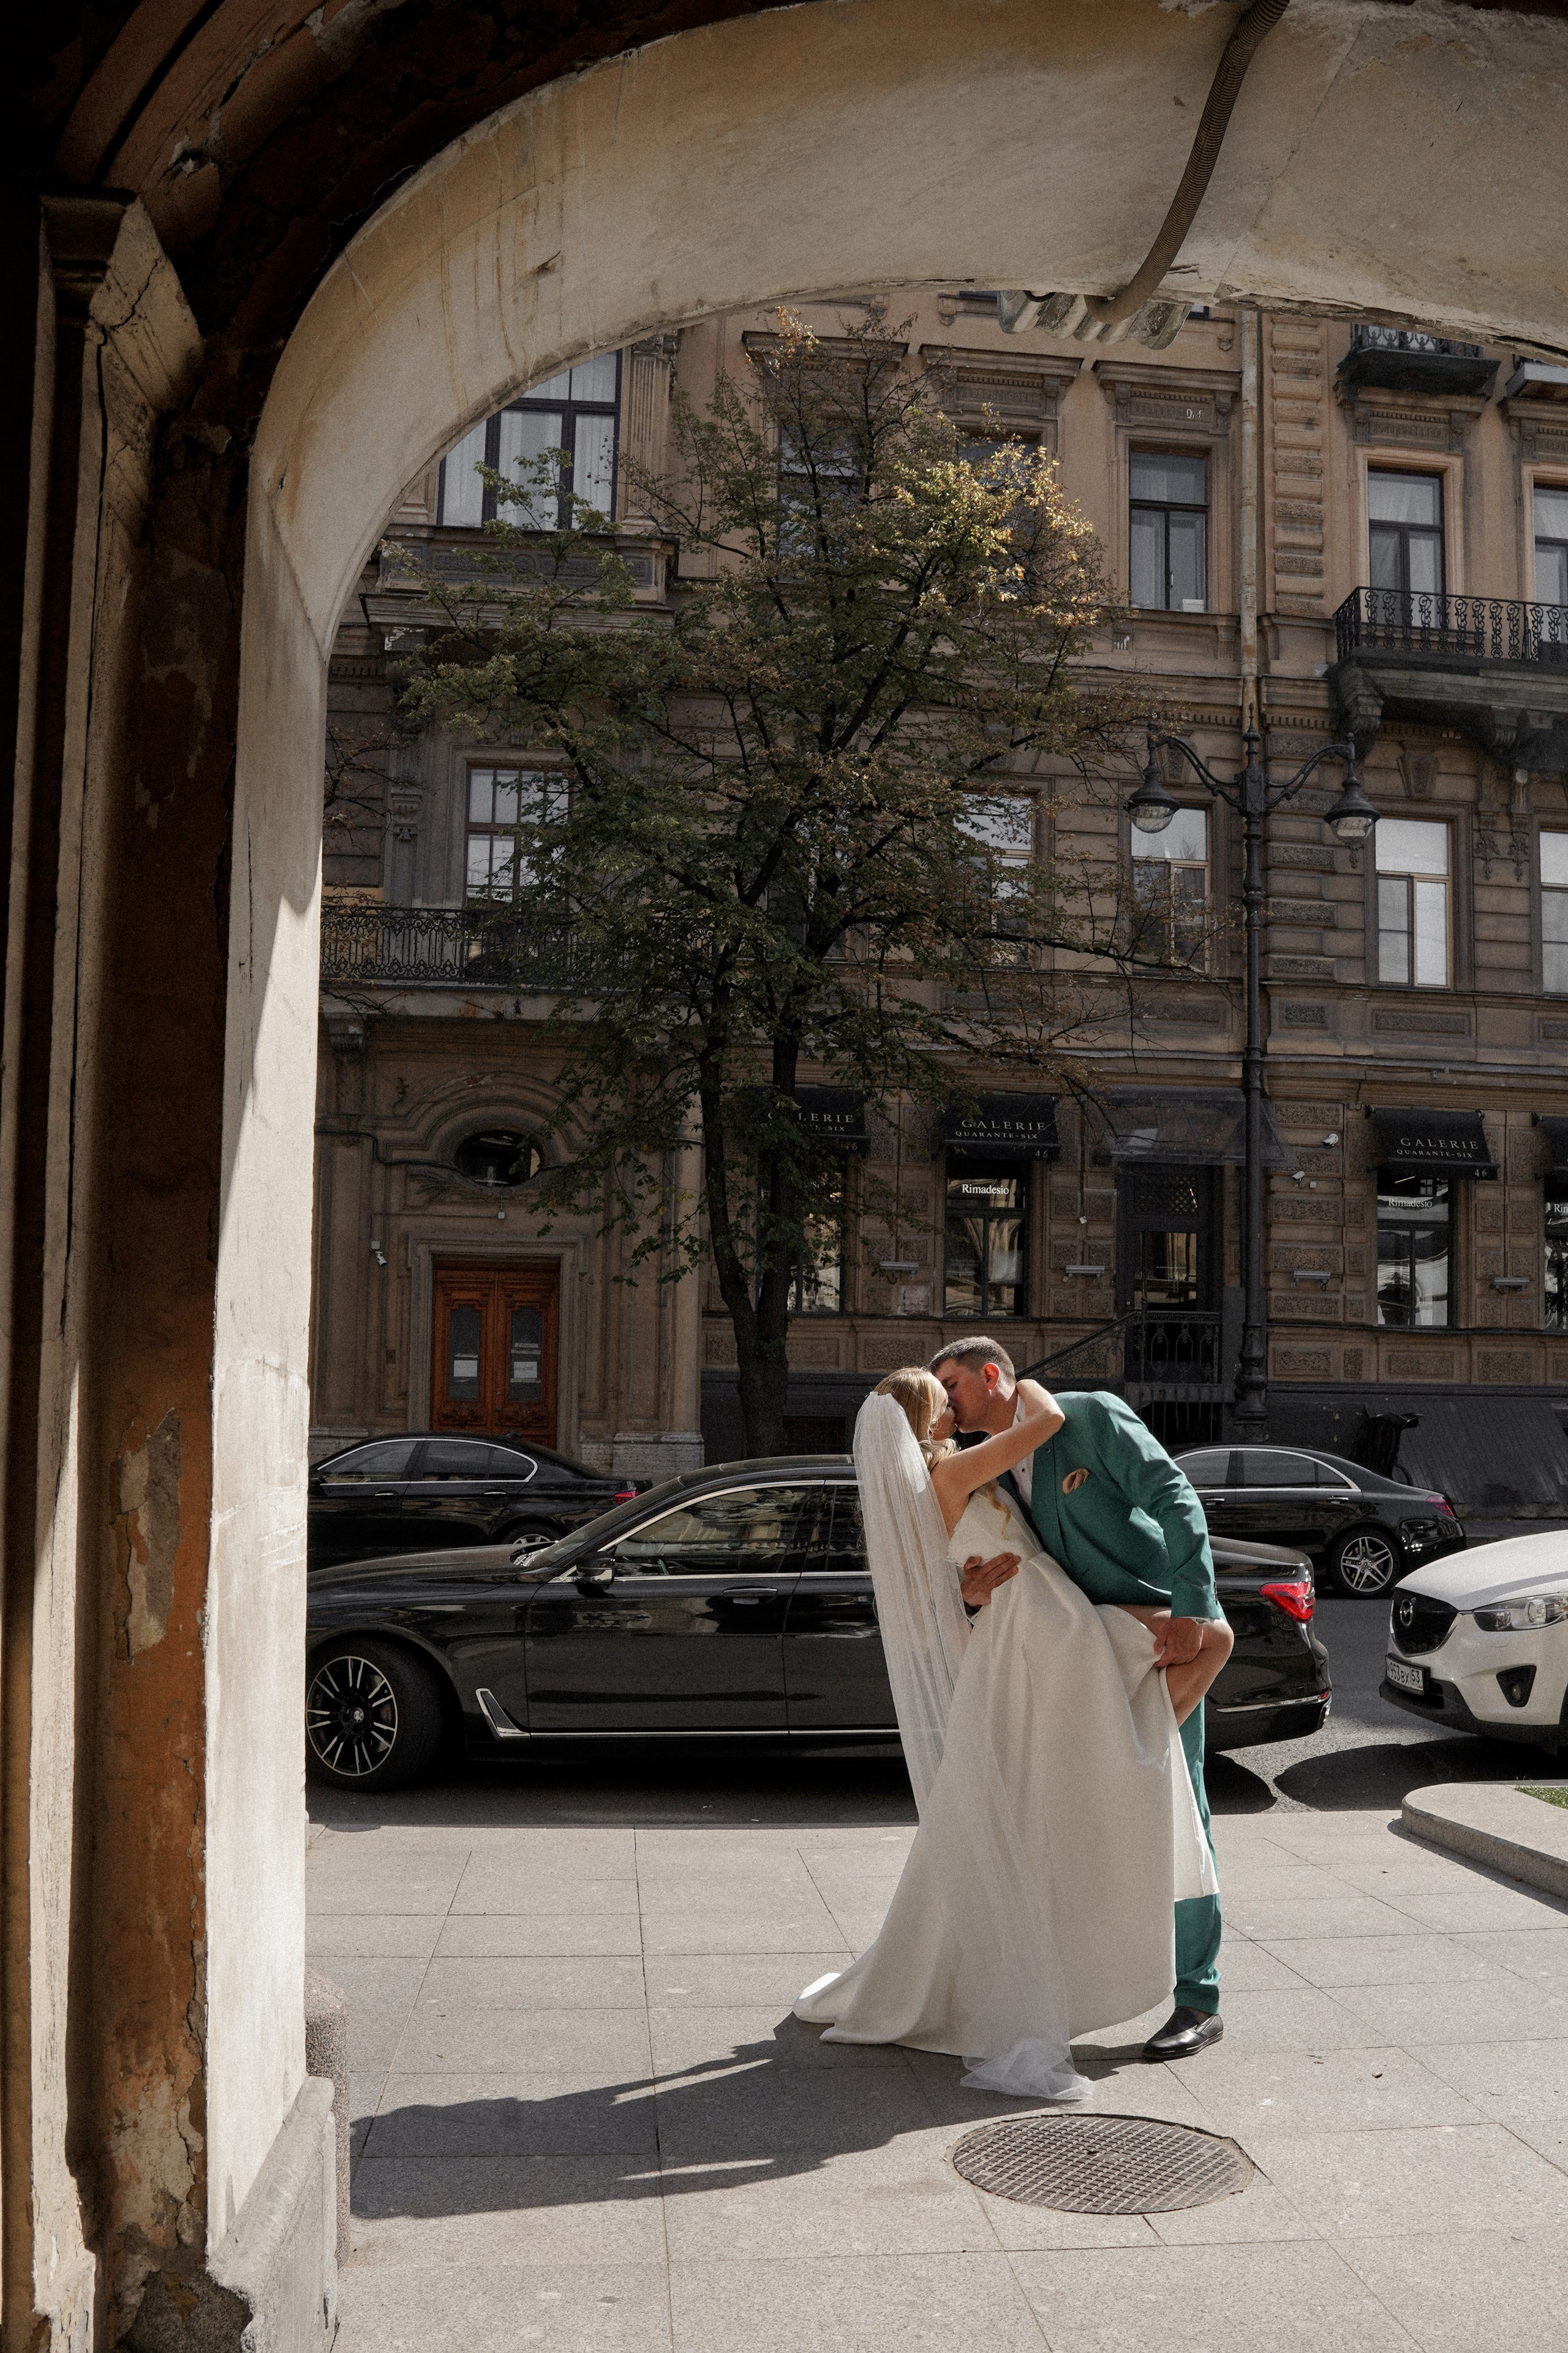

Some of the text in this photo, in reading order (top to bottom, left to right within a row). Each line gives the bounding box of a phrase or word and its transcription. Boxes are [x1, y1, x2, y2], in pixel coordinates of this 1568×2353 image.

[962, 1120, 1045, 1130] GALERIE
[1400, 1138, 1479, 1149] GALERIE
[1035, 1149, 1049, 1158] 46
[1396, 1149, 1473, 1158] QUARANTE-SIX
[962, 1184, 1010, 1195] Rimadesio
[1388, 1198, 1433, 1208] Rimadesio
[1411, 1669, 1420, 1683] 53
